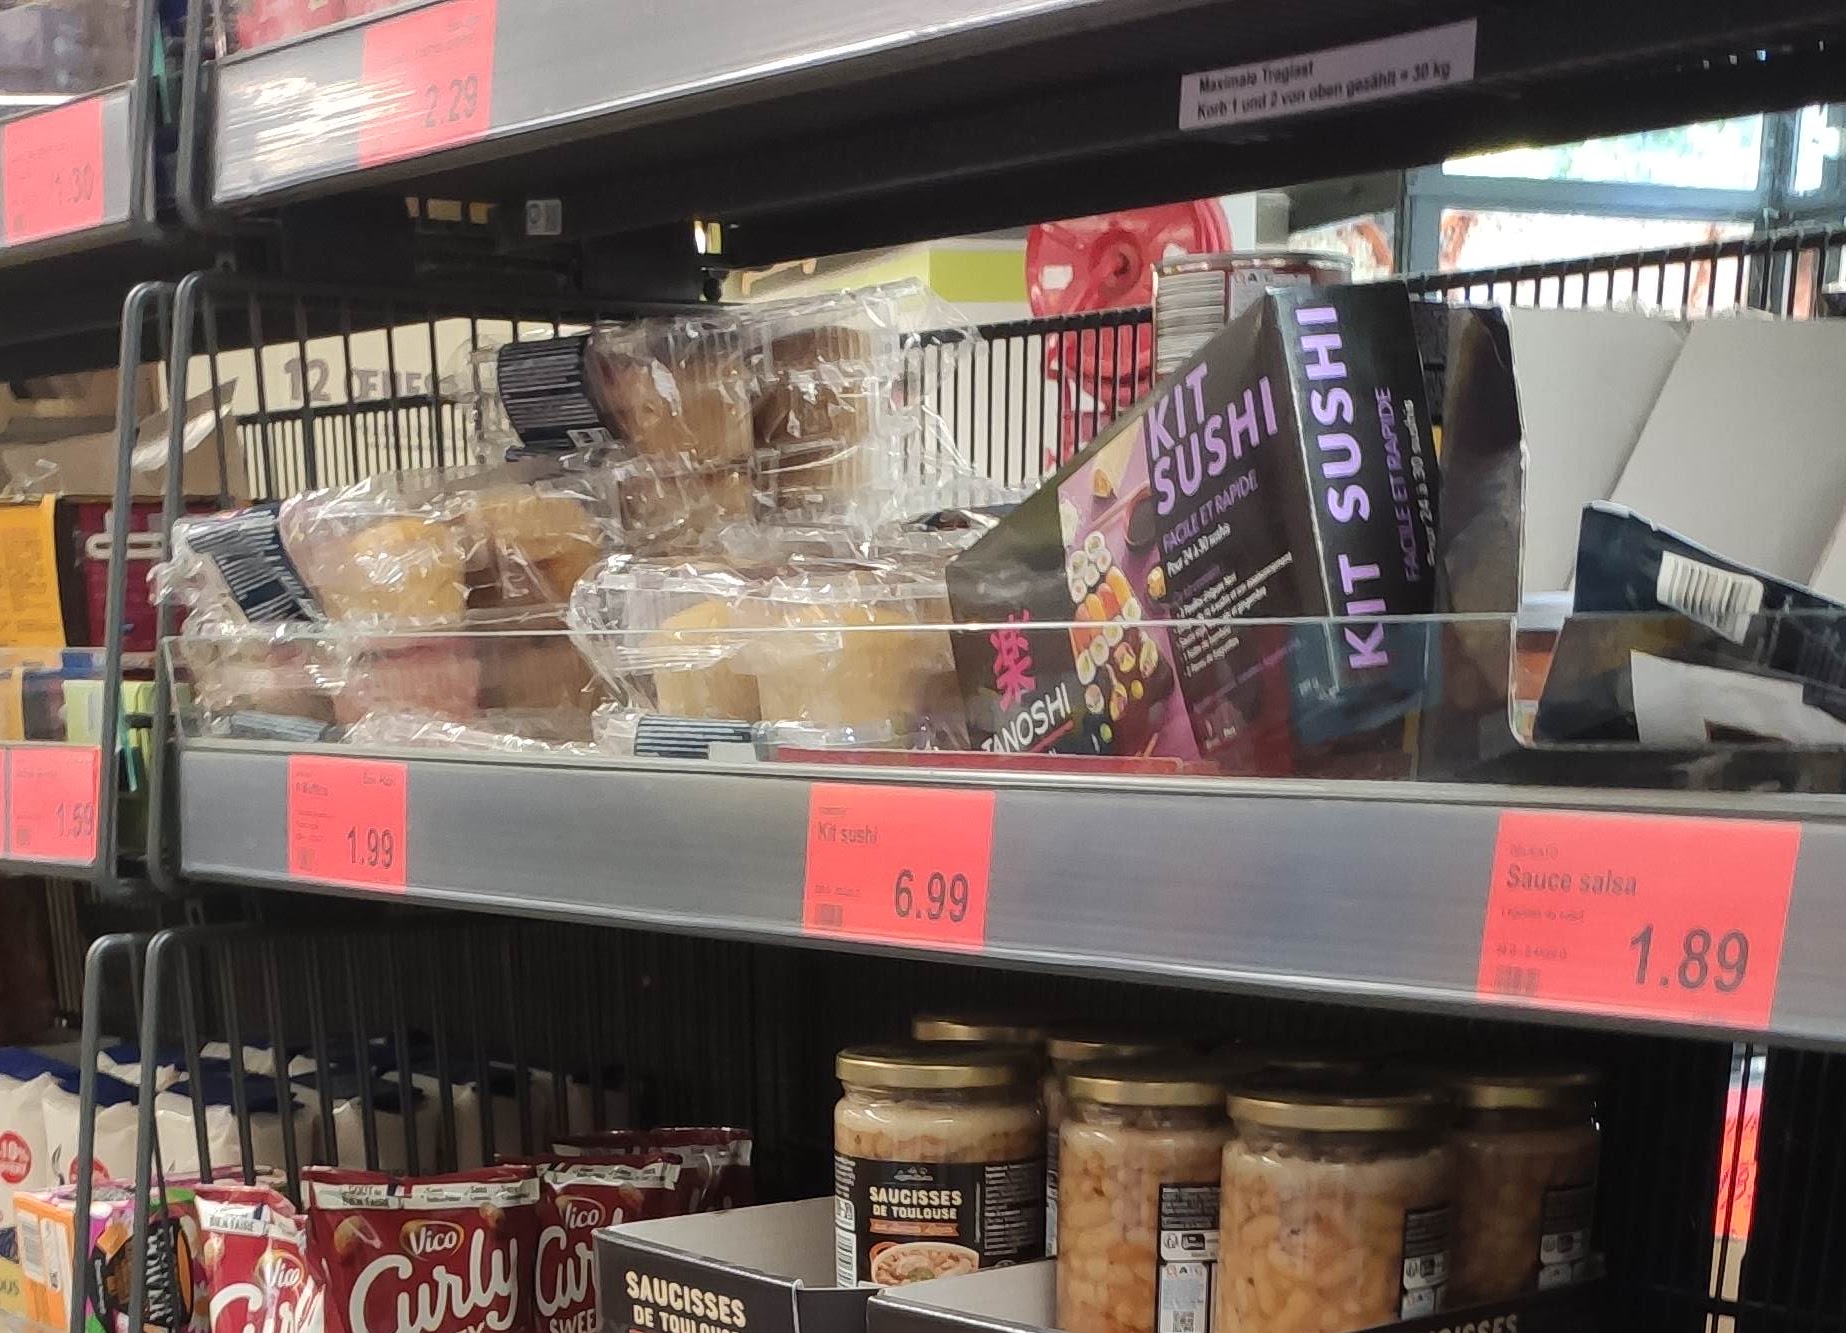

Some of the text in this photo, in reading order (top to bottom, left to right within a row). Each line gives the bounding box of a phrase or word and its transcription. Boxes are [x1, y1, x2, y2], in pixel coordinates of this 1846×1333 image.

[423, 75, 479, 128] 2.29
[1197, 99, 1228, 120] Korb
[1241, 95, 1267, 113] und
[1278, 91, 1306, 106] von
[1309, 83, 1342, 101] oben
[1433, 59, 1451, 80] kg
[1199, 69, 1257, 94] Maximale
[283, 357, 332, 401] 12
[1146, 362, 1208, 459] KIT
[1153, 375, 1279, 516] SUSHI
[1295, 304, 1390, 671] KIT SUSHI
[980, 681, 1071, 753] TANOSHI
[345, 825, 394, 869] 1.99
[817, 821, 878, 846] Kit sushi
[893, 867, 969, 923] 6.99
[1505, 863, 1638, 897] Sauce salsa
[1629, 924, 1750, 993] 1.89
[869, 1186, 963, 1206] SAUCISSES
[872, 1205, 958, 1221] DE TOULOUSE
[409, 1226, 458, 1256] Vico
[624, 1269, 747, 1329] SAUCISSES
[632, 1303, 655, 1329] DE
